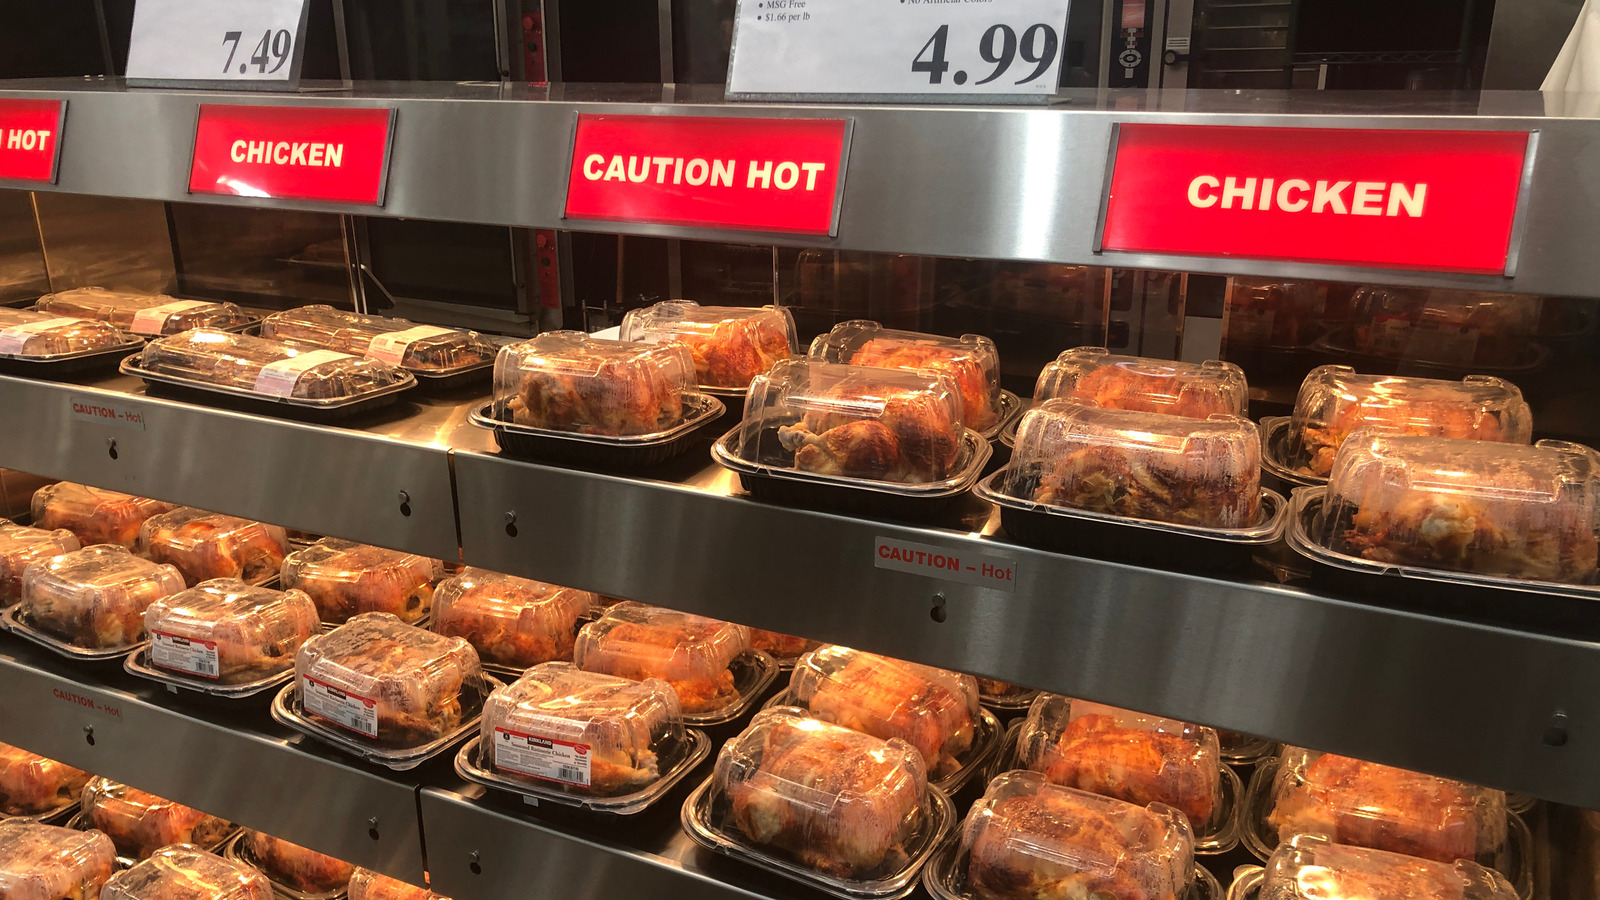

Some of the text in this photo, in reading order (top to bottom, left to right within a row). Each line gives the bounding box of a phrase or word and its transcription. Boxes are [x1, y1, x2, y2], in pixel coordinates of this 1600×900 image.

[765, 11, 811, 23] $1.66 per lb
[766, 0, 806, 9] MSG Free
[222, 29, 291, 74] 7.49
[911, 23, 1058, 86] 4.99
[7, 130, 50, 151] HOT
[231, 140, 343, 167] CHICKEN
[583, 154, 825, 191] CAUTION HOT
[1187, 175, 1427, 217] CHICKEN
[72, 403, 115, 419] CAUTION
[125, 411, 142, 423] Hot
[878, 545, 960, 571] CAUTION
[981, 563, 1012, 581] Hot
[53, 688, 94, 709] CAUTION
[104, 704, 120, 717] Hot
[528, 736, 552, 746] KIRKLAND
[552, 750, 571, 759] Chicken
